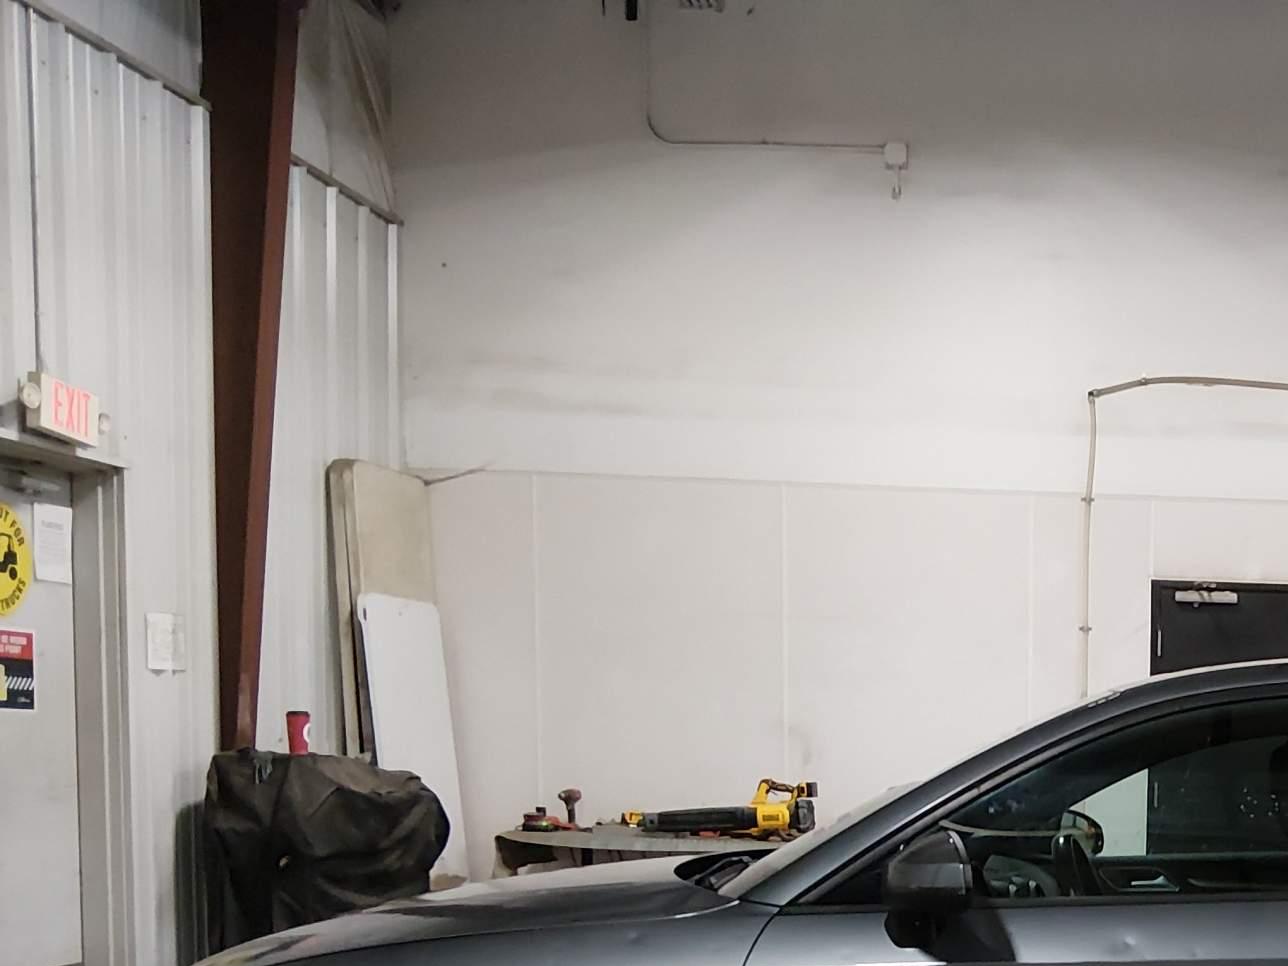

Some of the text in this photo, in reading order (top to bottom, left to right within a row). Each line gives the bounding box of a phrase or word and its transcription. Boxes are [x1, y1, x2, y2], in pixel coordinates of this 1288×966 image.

[52, 379, 91, 437] EXIT
[9, 519, 25, 546] FOR
[0, 577, 26, 610] TRUCKS
